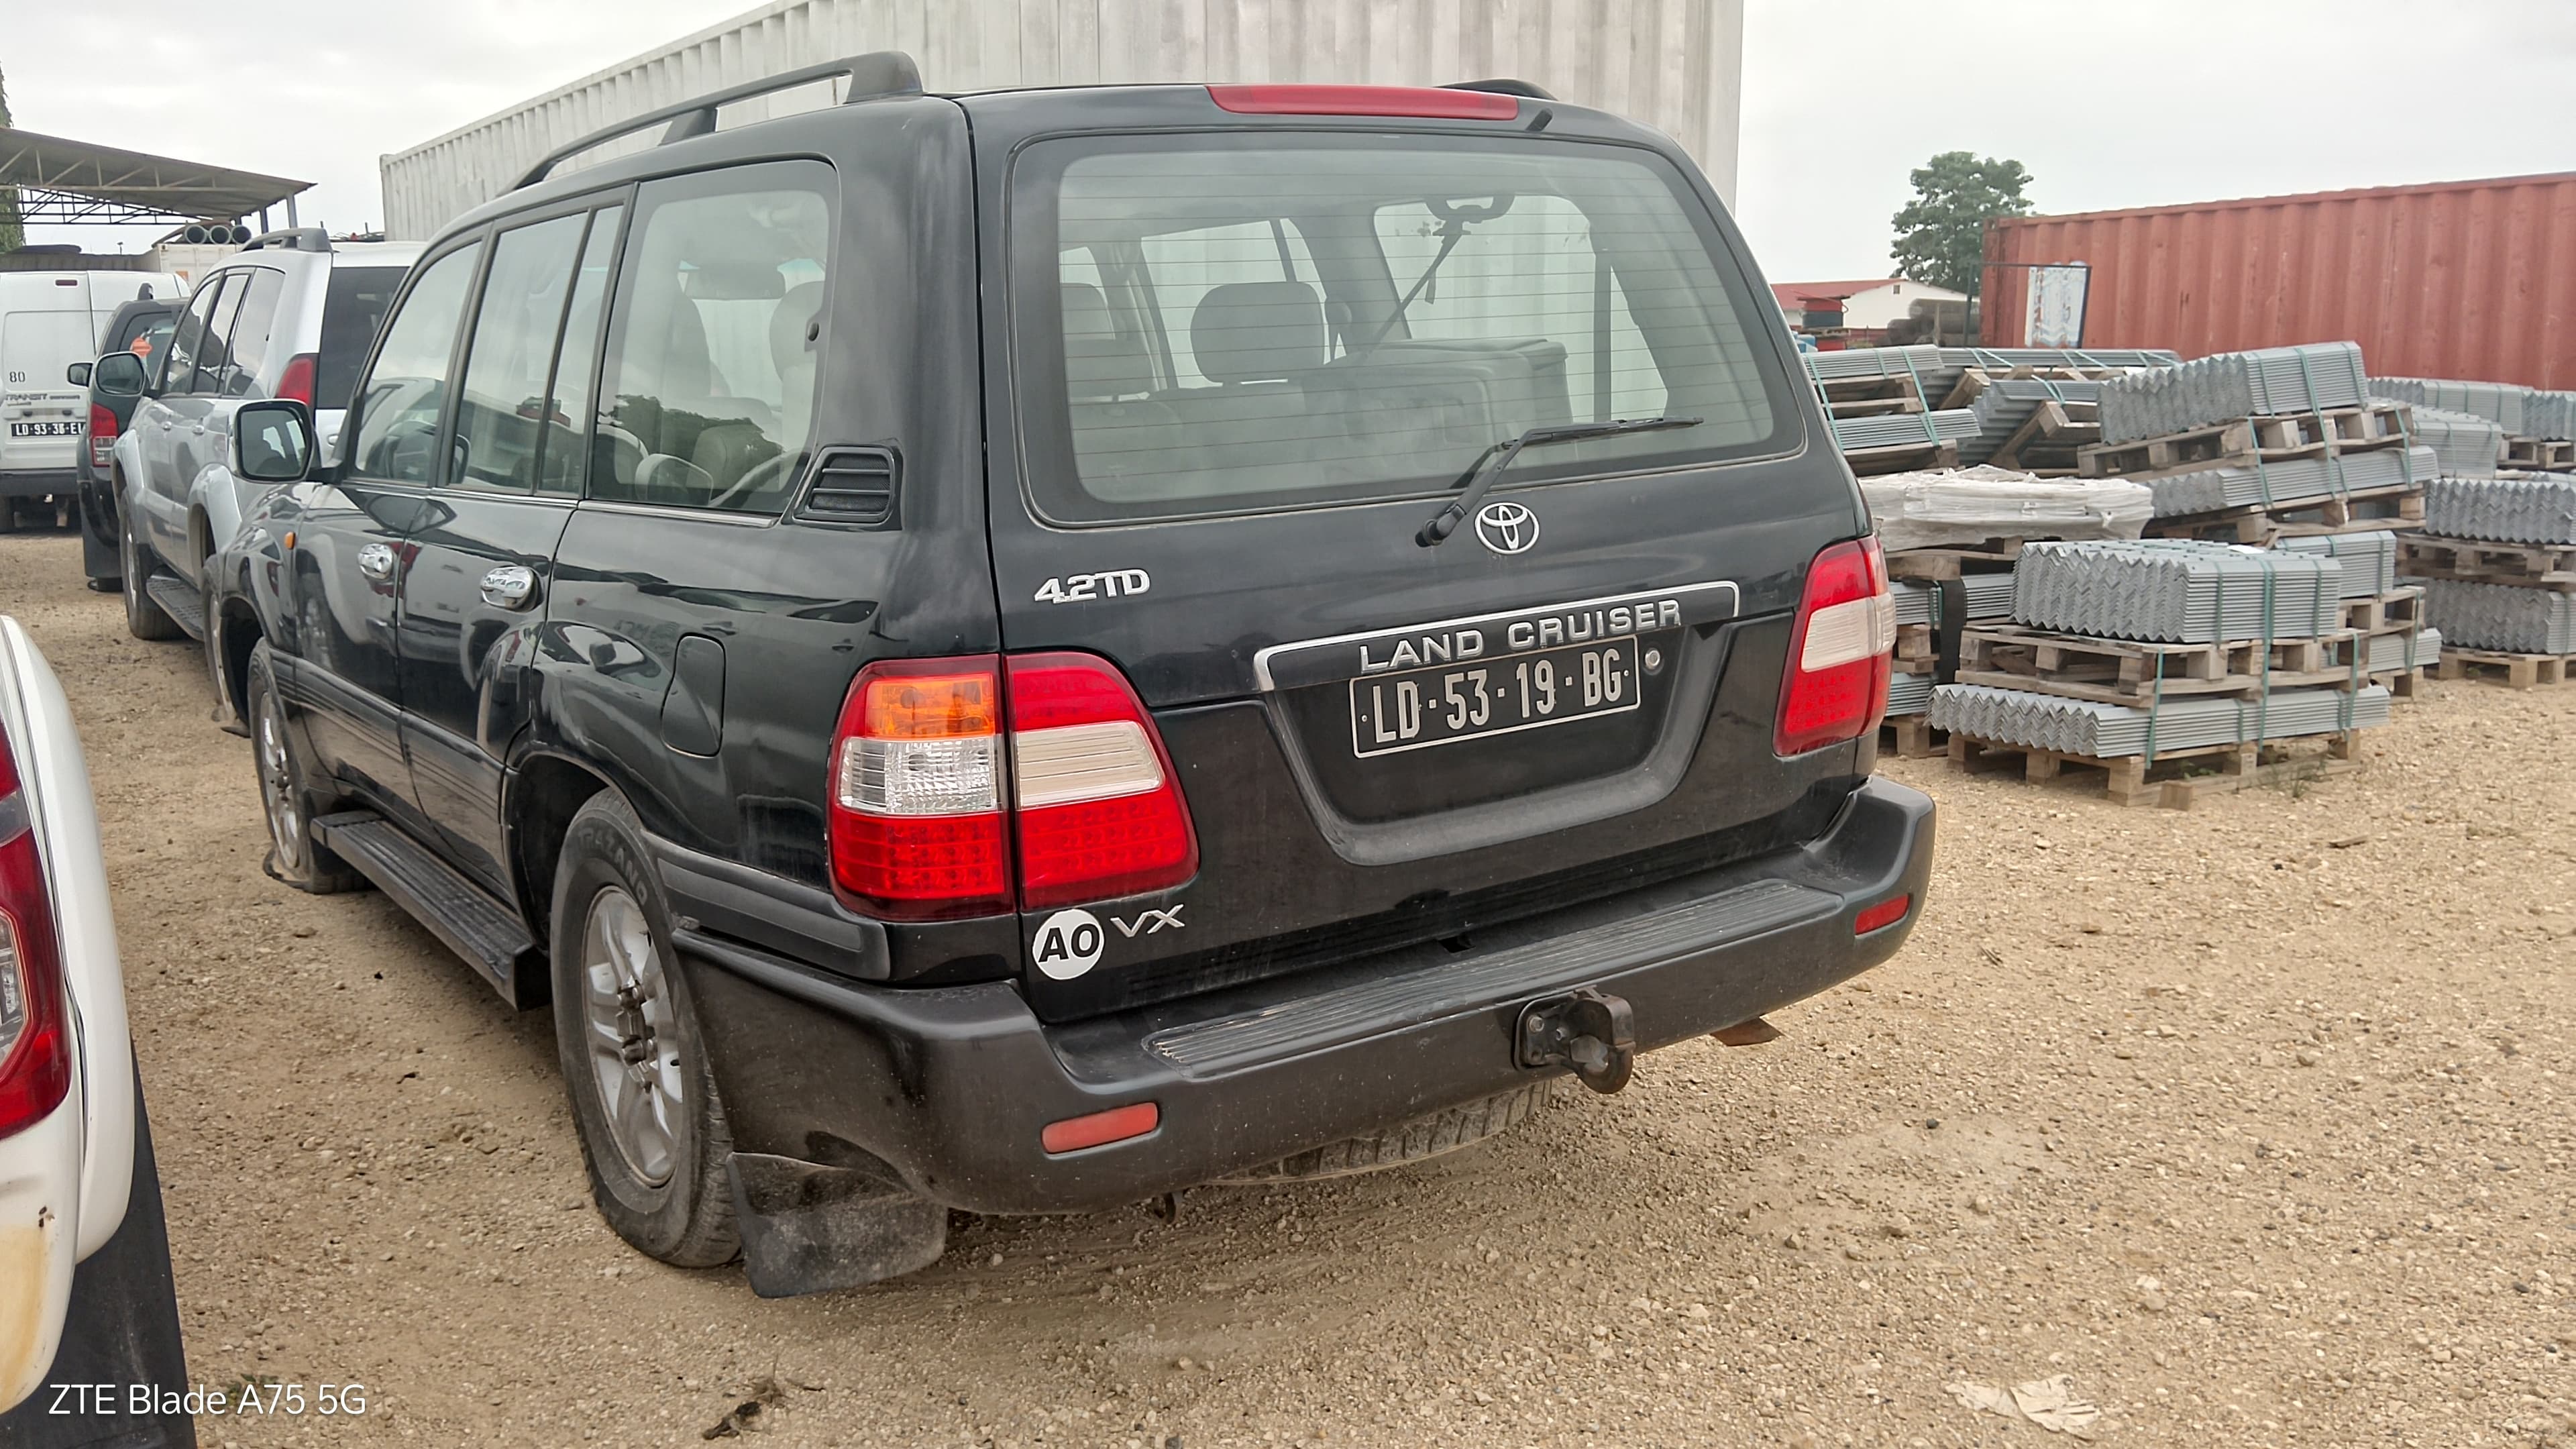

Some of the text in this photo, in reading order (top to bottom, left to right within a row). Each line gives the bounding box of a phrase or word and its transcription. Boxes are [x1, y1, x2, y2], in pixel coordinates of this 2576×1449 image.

[9, 371, 25, 382] 80
[1360, 599, 1682, 674] LAND CRUISER
[1110, 904, 1185, 938] VX
[1038, 922, 1101, 963] AO
